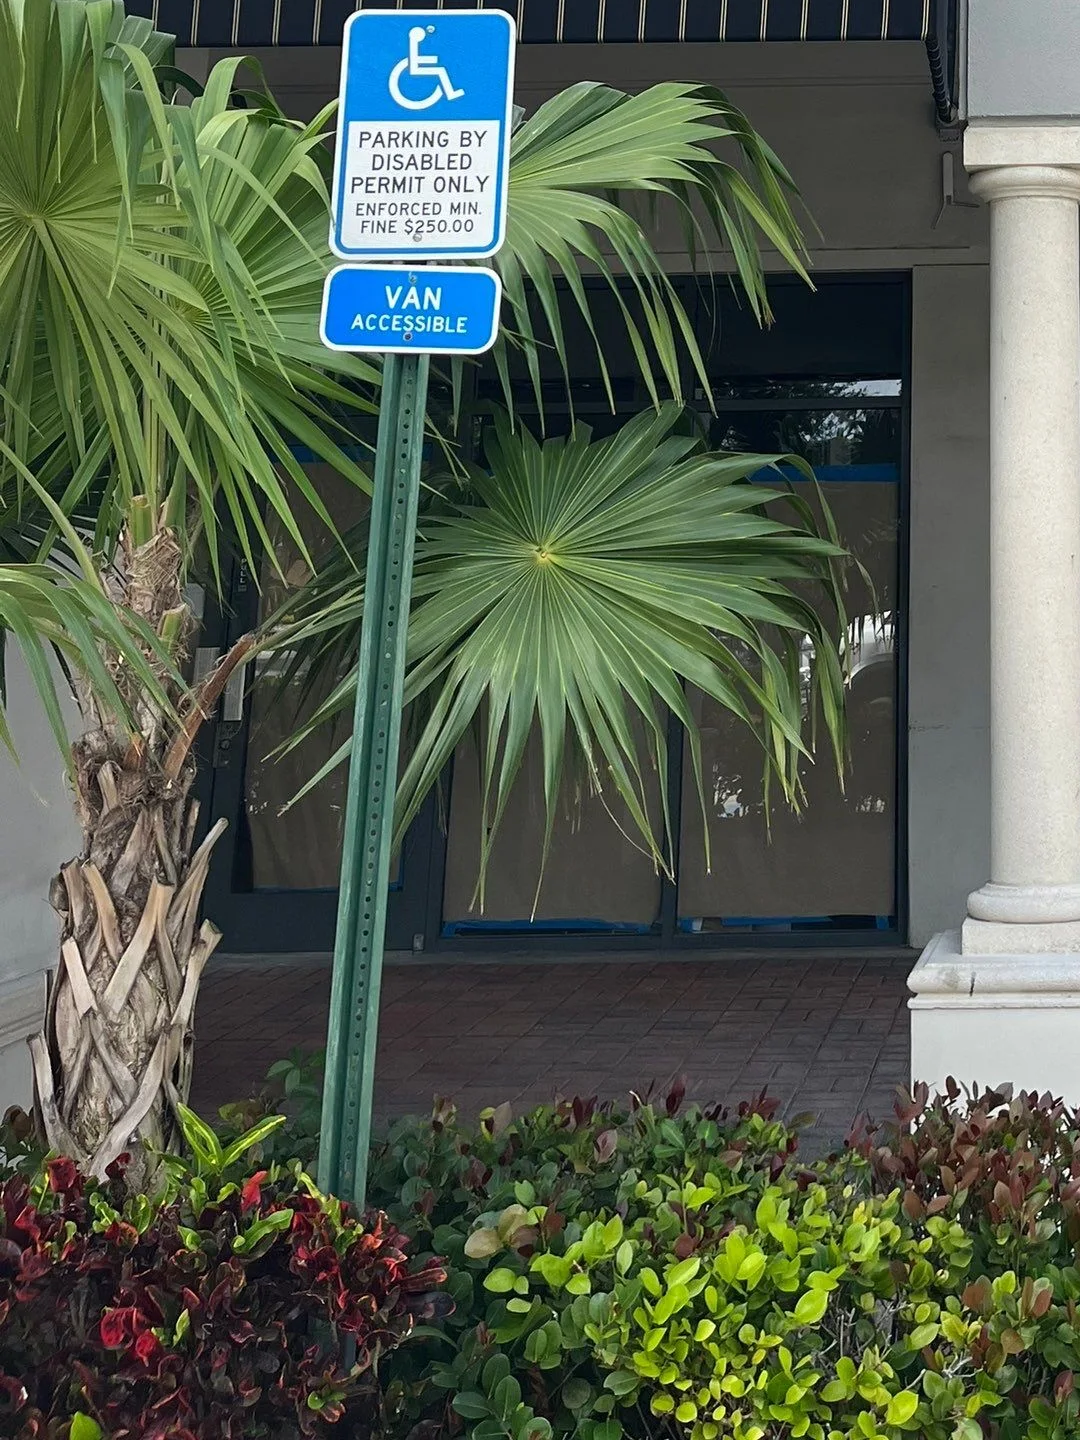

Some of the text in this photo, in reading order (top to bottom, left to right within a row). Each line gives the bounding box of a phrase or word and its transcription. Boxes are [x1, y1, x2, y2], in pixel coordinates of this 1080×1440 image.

[358, 130, 488, 148] PARKING BY
[371, 153, 472, 171] DISABLED
[350, 175, 490, 194] PERMIT ONLY
[355, 203, 483, 217] ENFORCED MIN.
[360, 218, 475, 234] FINE $250.00
[385, 285, 443, 311] VAN
[350, 314, 469, 334] ACCESSIBLE
